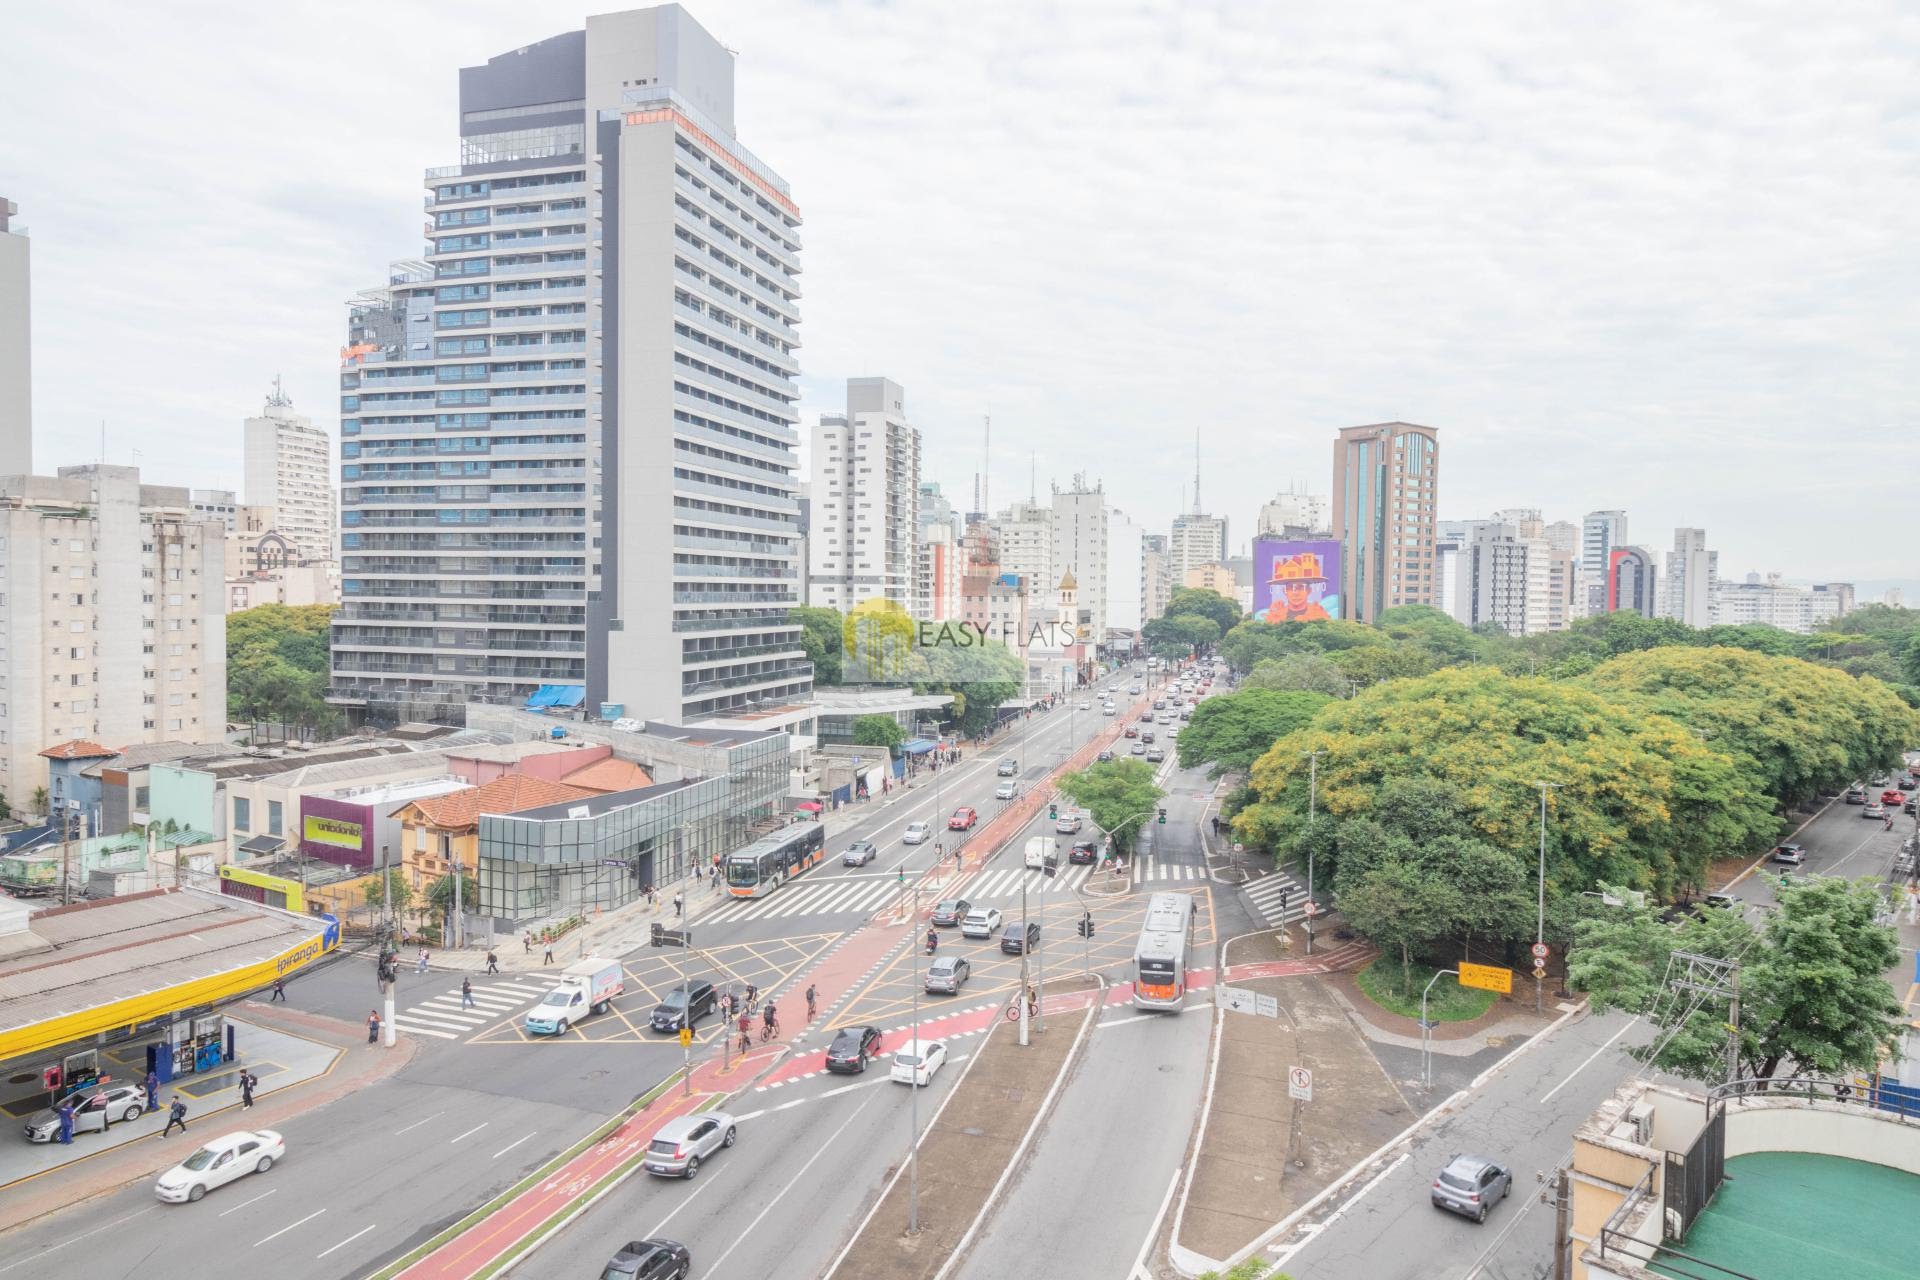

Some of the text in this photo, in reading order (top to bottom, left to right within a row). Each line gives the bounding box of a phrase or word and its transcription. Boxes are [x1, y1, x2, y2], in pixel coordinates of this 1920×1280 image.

[318, 822, 360, 837] uniodonto
[1535, 945, 1546, 954] 50
[277, 942, 319, 974] Ipiranga
